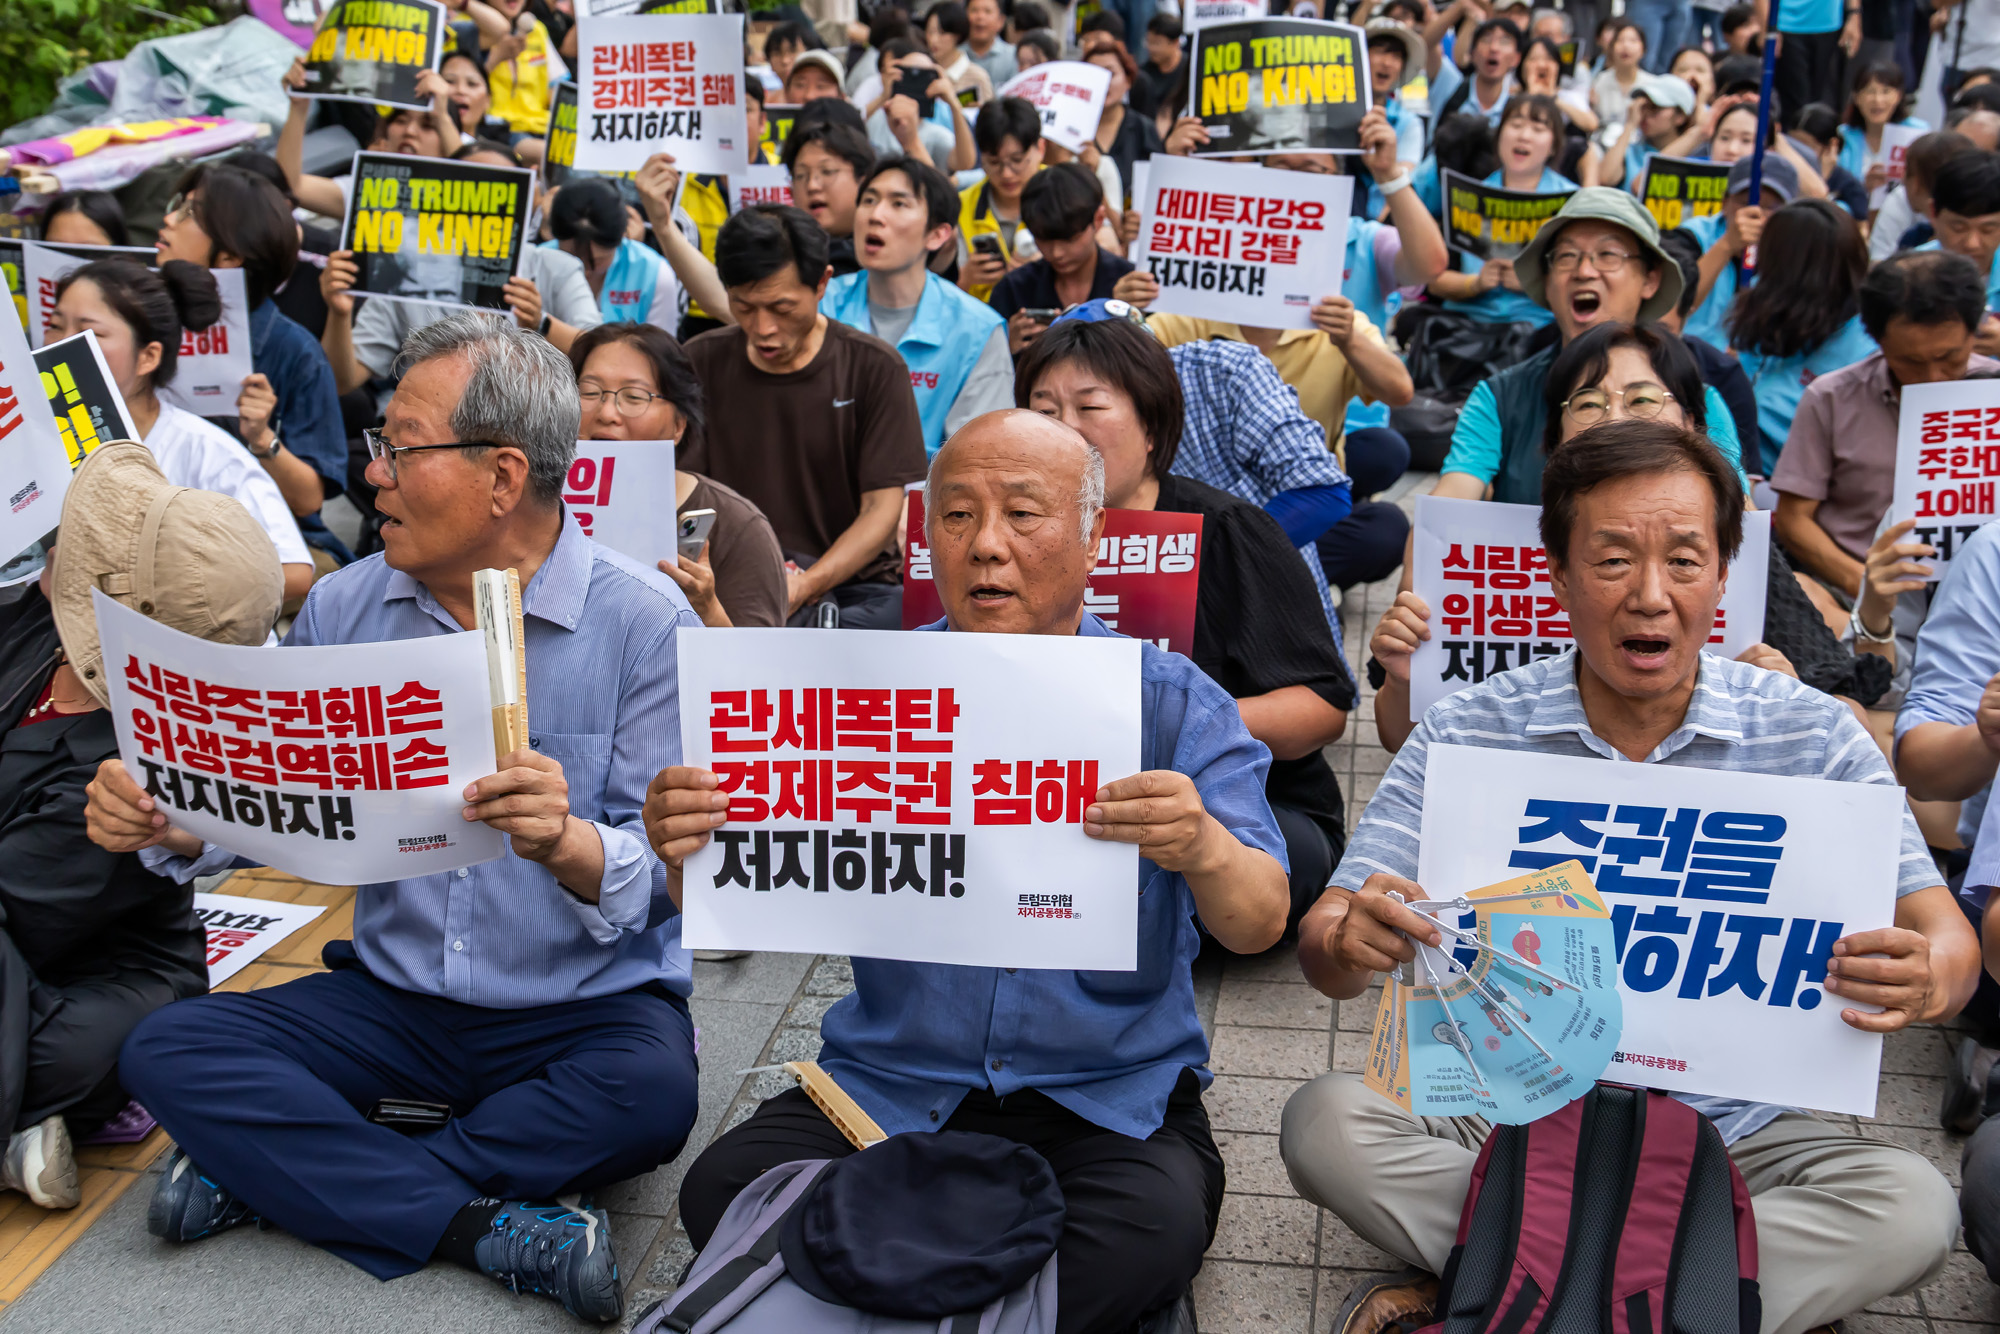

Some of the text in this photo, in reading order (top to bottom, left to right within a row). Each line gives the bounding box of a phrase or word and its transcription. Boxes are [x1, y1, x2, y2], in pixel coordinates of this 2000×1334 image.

[343, 0, 430, 34] TRUMP!
[345, 26, 428, 67] KING!
[592, 41, 696, 75] 관세폭탄
[1203, 35, 1353, 76] NO TRUMP!
[592, 74, 736, 109] 경제주권 침해
[1201, 64, 1357, 117] NO KING!
[591, 109, 702, 142] 저지하자!
[359, 177, 519, 215] NO TRUMP!
[1451, 186, 1478, 211] NO
[1649, 173, 1729, 200] NO TRU
[1155, 187, 1325, 231] 대미투자강요
[1451, 205, 1550, 244] NO KIN
[1645, 199, 1681, 230] NO
[352, 210, 515, 259] NO KING!
[1150, 222, 1302, 265] 일자리 강탈
[1147, 256, 1267, 297] 저지하자!
[909, 371, 940, 389] 보당
[1915, 482, 1995, 518] 10배
[1441, 543, 1550, 590] 식량
[1441, 640, 1575, 684] 저지
[123, 653, 444, 738] 식량주권훼손
[709, 687, 961, 753] 관세폭탄
[131, 706, 449, 791] 위생검역훼손
[137, 755, 357, 841] 저지하자!
[711, 759, 1099, 826] 경제주권 침해
[397, 832, 448, 847] 트럼프위협
[1507, 798, 1788, 905] 주권을
[712, 828, 966, 898] 저지하자!
[1017, 893, 1073, 908] 트럼프위협
